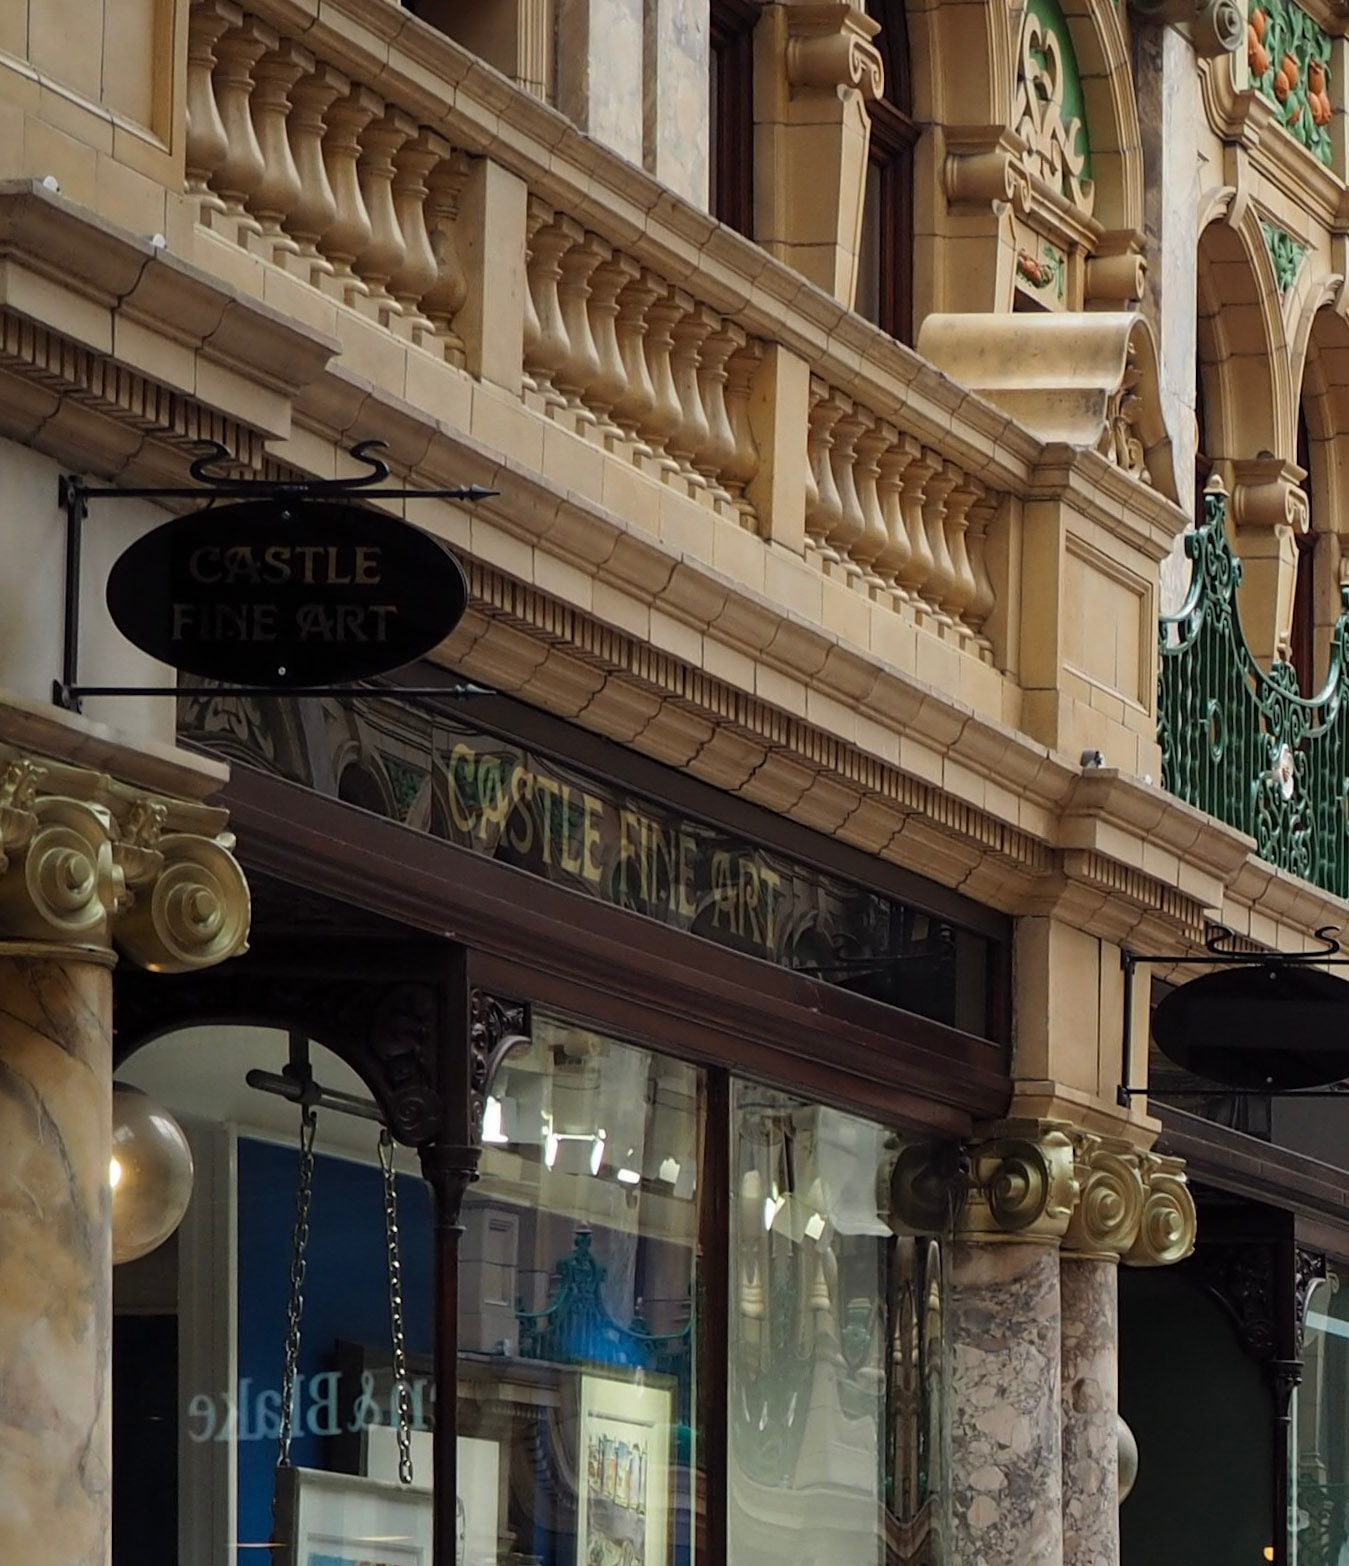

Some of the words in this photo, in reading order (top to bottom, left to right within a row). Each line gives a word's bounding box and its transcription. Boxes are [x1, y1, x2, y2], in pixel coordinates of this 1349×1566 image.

[189, 546, 382, 584] CASTLE
[171, 603, 279, 641] FINE
[296, 604, 398, 642] ART
[448, 743, 604, 882] CASTLE
[619, 807, 699, 917] FINE
[711, 852, 781, 949] ART
